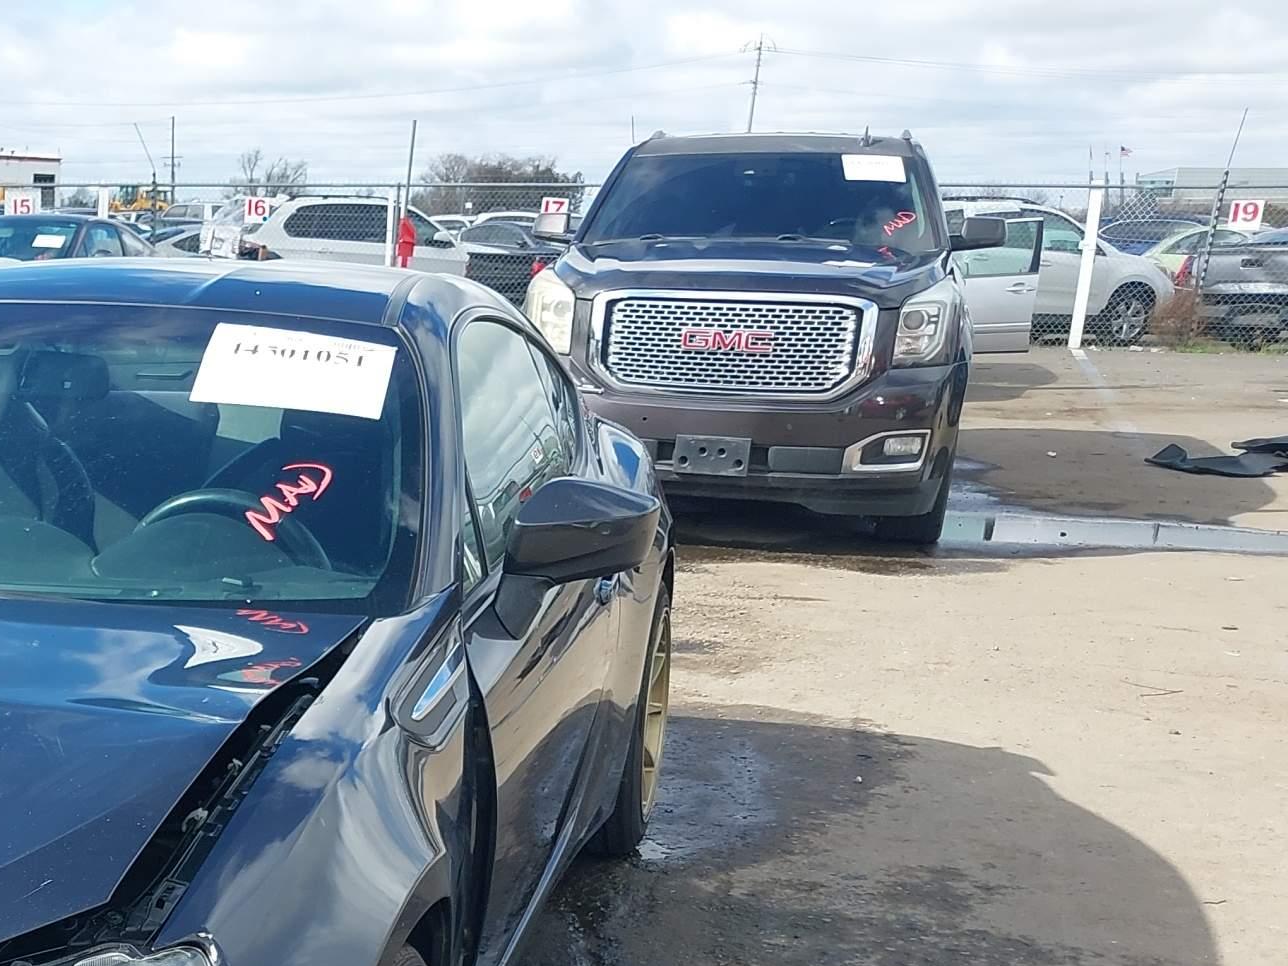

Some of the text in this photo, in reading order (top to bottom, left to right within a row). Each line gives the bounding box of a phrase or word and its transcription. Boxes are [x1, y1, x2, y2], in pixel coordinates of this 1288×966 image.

[13, 199, 31, 215] 15
[247, 199, 266, 217] 16
[544, 200, 565, 213] 17
[1231, 202, 1260, 223] 19
[680, 328, 774, 353] GMC
